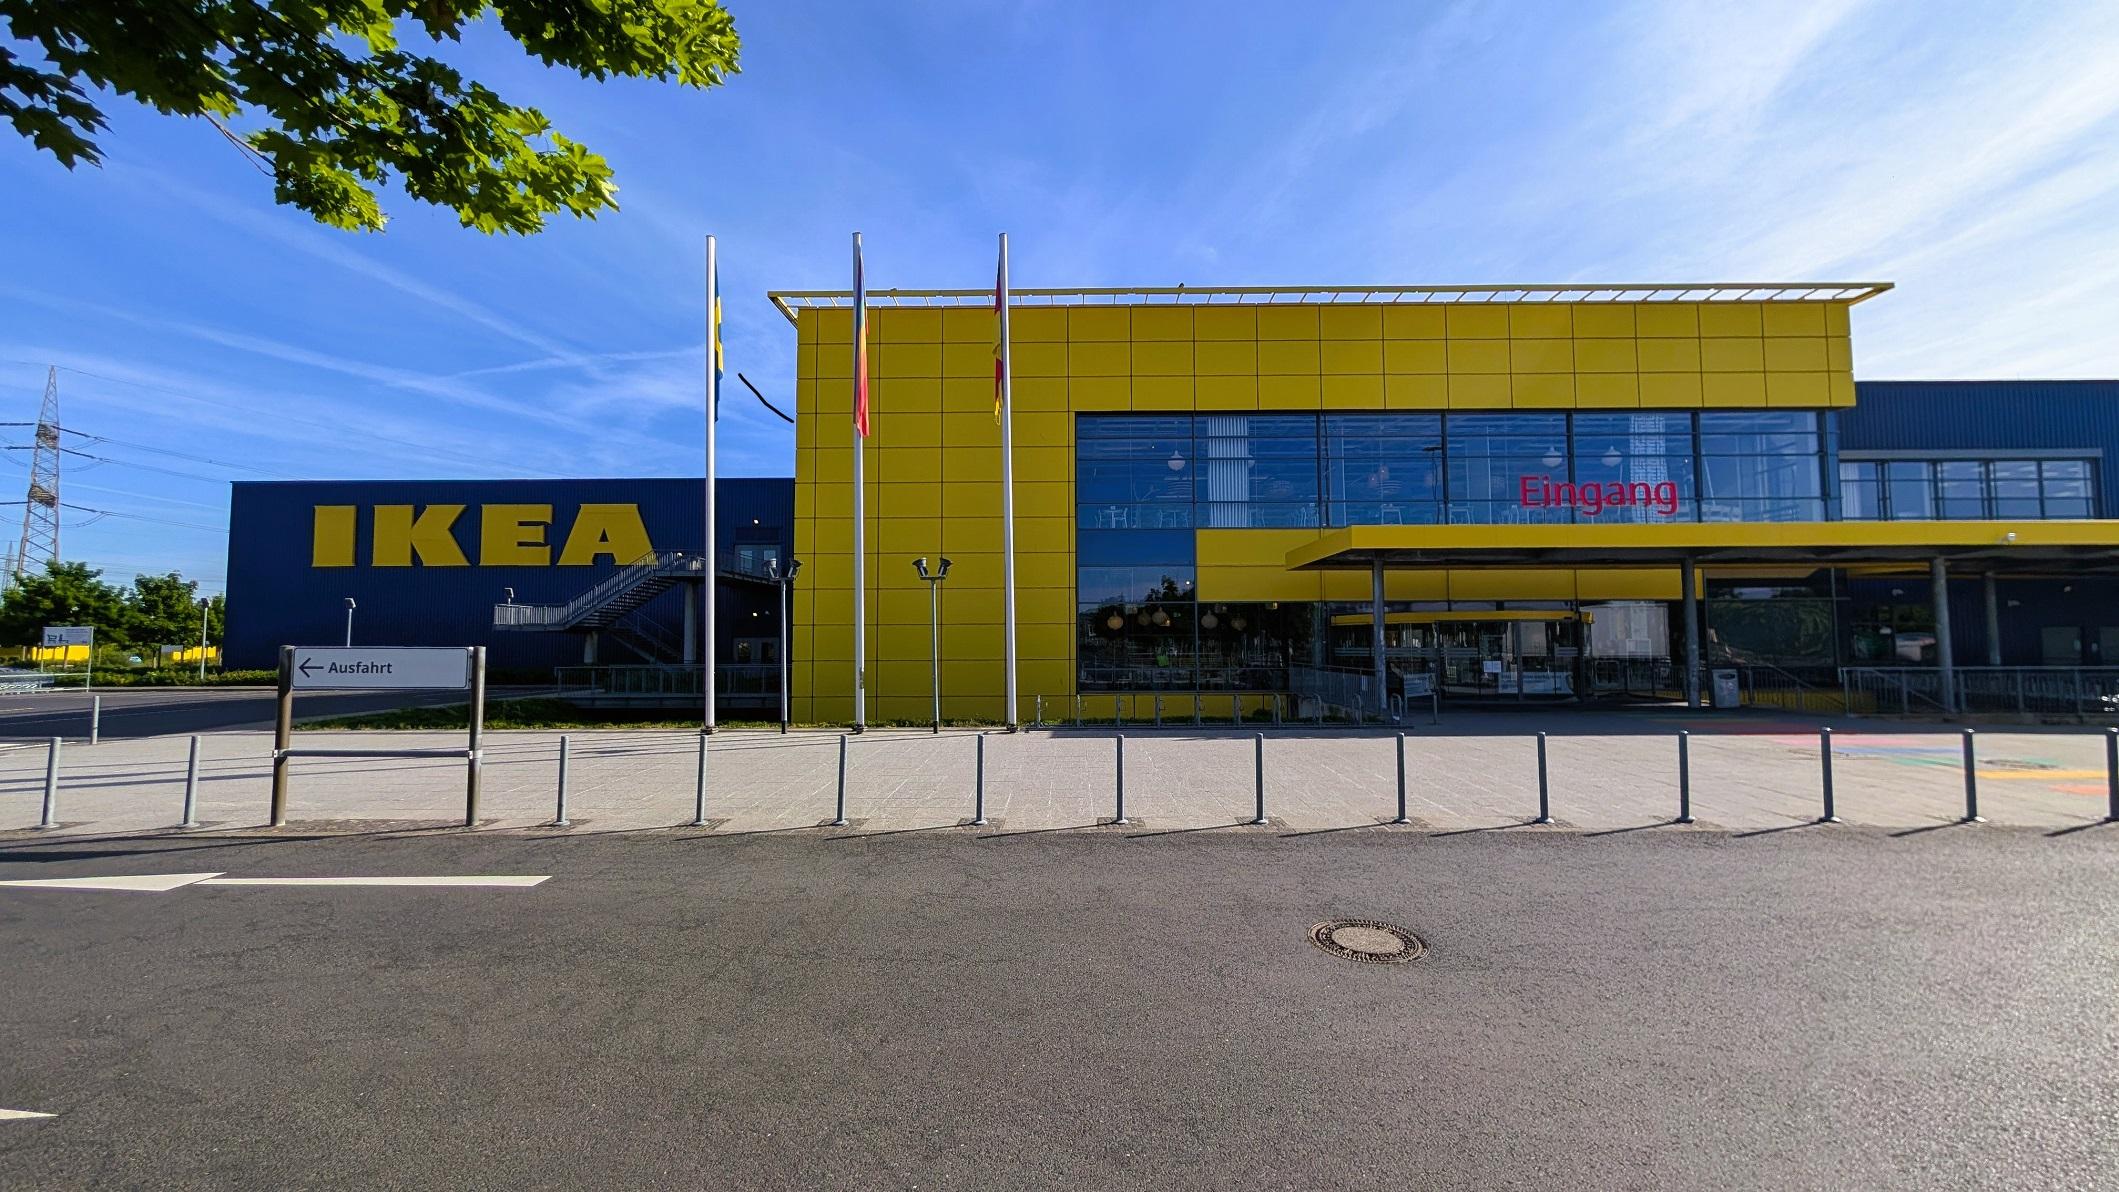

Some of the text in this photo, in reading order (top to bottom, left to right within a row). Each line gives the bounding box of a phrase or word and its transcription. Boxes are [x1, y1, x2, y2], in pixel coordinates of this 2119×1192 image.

[1520, 475, 1679, 515] Eingang
[311, 504, 659, 567] IKEA
[328, 661, 393, 674] Ausfahrt
